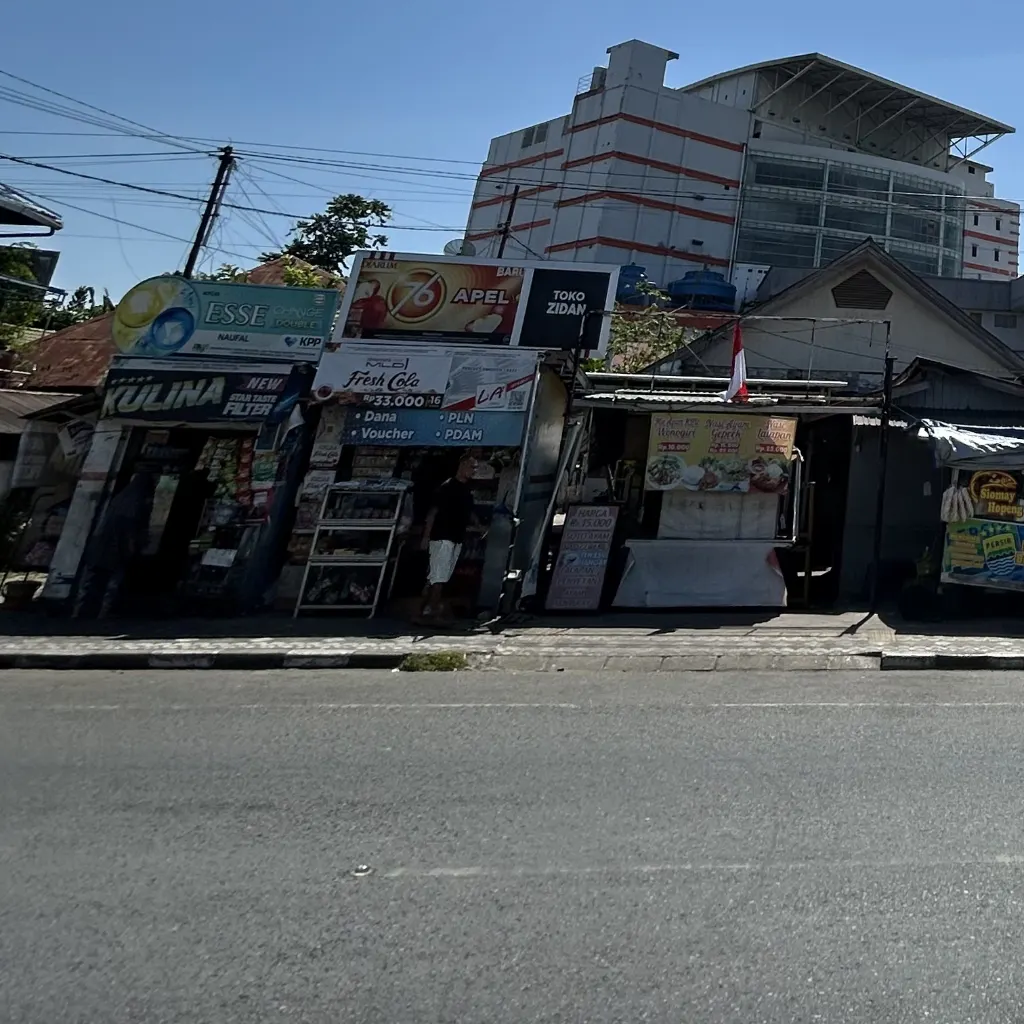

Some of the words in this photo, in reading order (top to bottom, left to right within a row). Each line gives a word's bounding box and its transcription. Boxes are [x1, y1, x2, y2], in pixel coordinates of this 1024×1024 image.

[452, 288, 510, 305] APEL
[553, 289, 586, 302] TOKO
[205, 302, 268, 327] ESSE
[546, 302, 588, 316] ZIDAN
[276, 319, 318, 329] DOUBLE
[218, 333, 250, 342] NAUFAL
[299, 337, 322, 347] KPP
[247, 377, 283, 390] NEW
[343, 370, 385, 388] Fresh
[387, 372, 420, 391] Cola
[100, 376, 227, 417] KULINA
[230, 393, 252, 403] STAR
[252, 394, 278, 404] TASTE
[222, 403, 273, 416] FILTER
[364, 410, 397, 423] Dana
[448, 411, 474, 424] PLN
[361, 427, 414, 441] Voucher
[444, 429, 483, 442] PDAM
[979, 489, 1016, 502] Siomay
[988, 501, 1024, 517] Hopeng
[986, 537, 1012, 547] PERSIB
